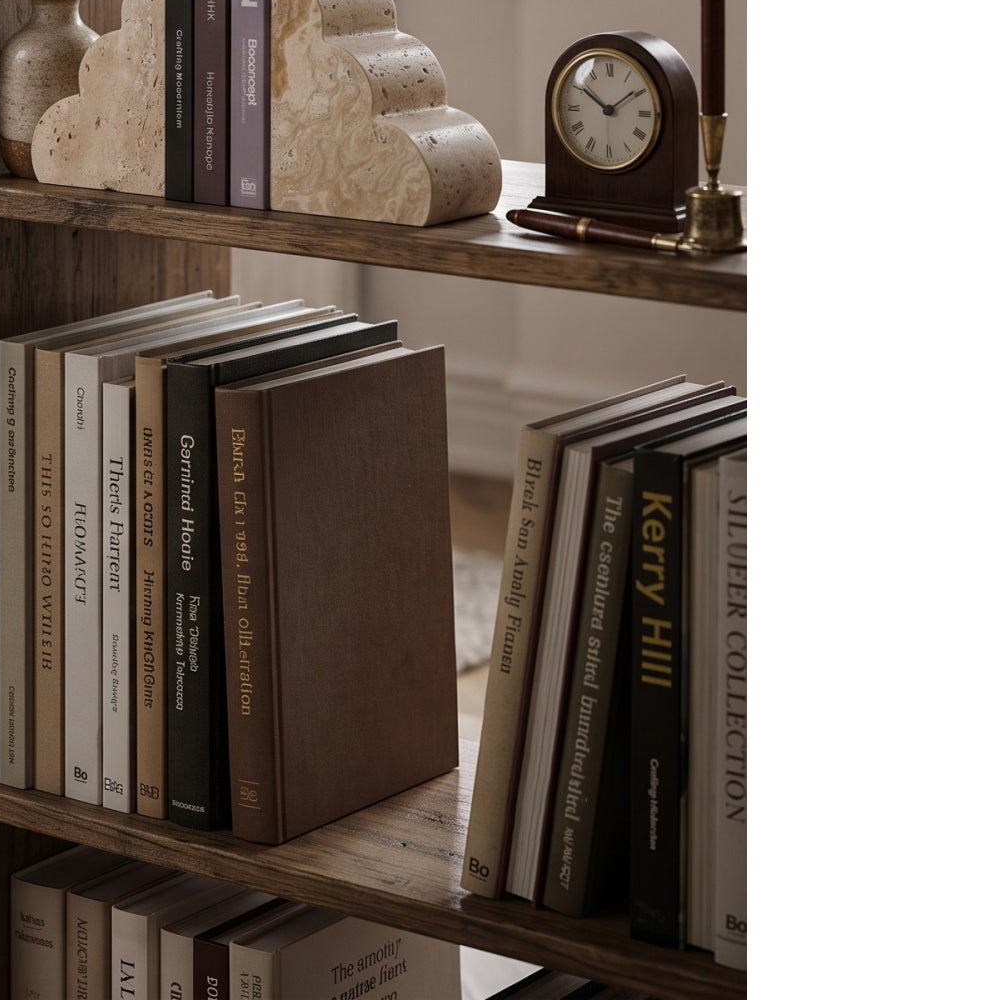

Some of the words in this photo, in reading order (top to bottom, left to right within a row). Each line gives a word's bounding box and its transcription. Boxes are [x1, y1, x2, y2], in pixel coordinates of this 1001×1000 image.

[602, 497, 623, 534] The
[635, 491, 672, 606] Kerry
[726, 631, 747, 823] COLLECTION
[74, 766, 88, 781] Bo
[469, 857, 490, 879] Bo
[331, 963, 354, 985] The
